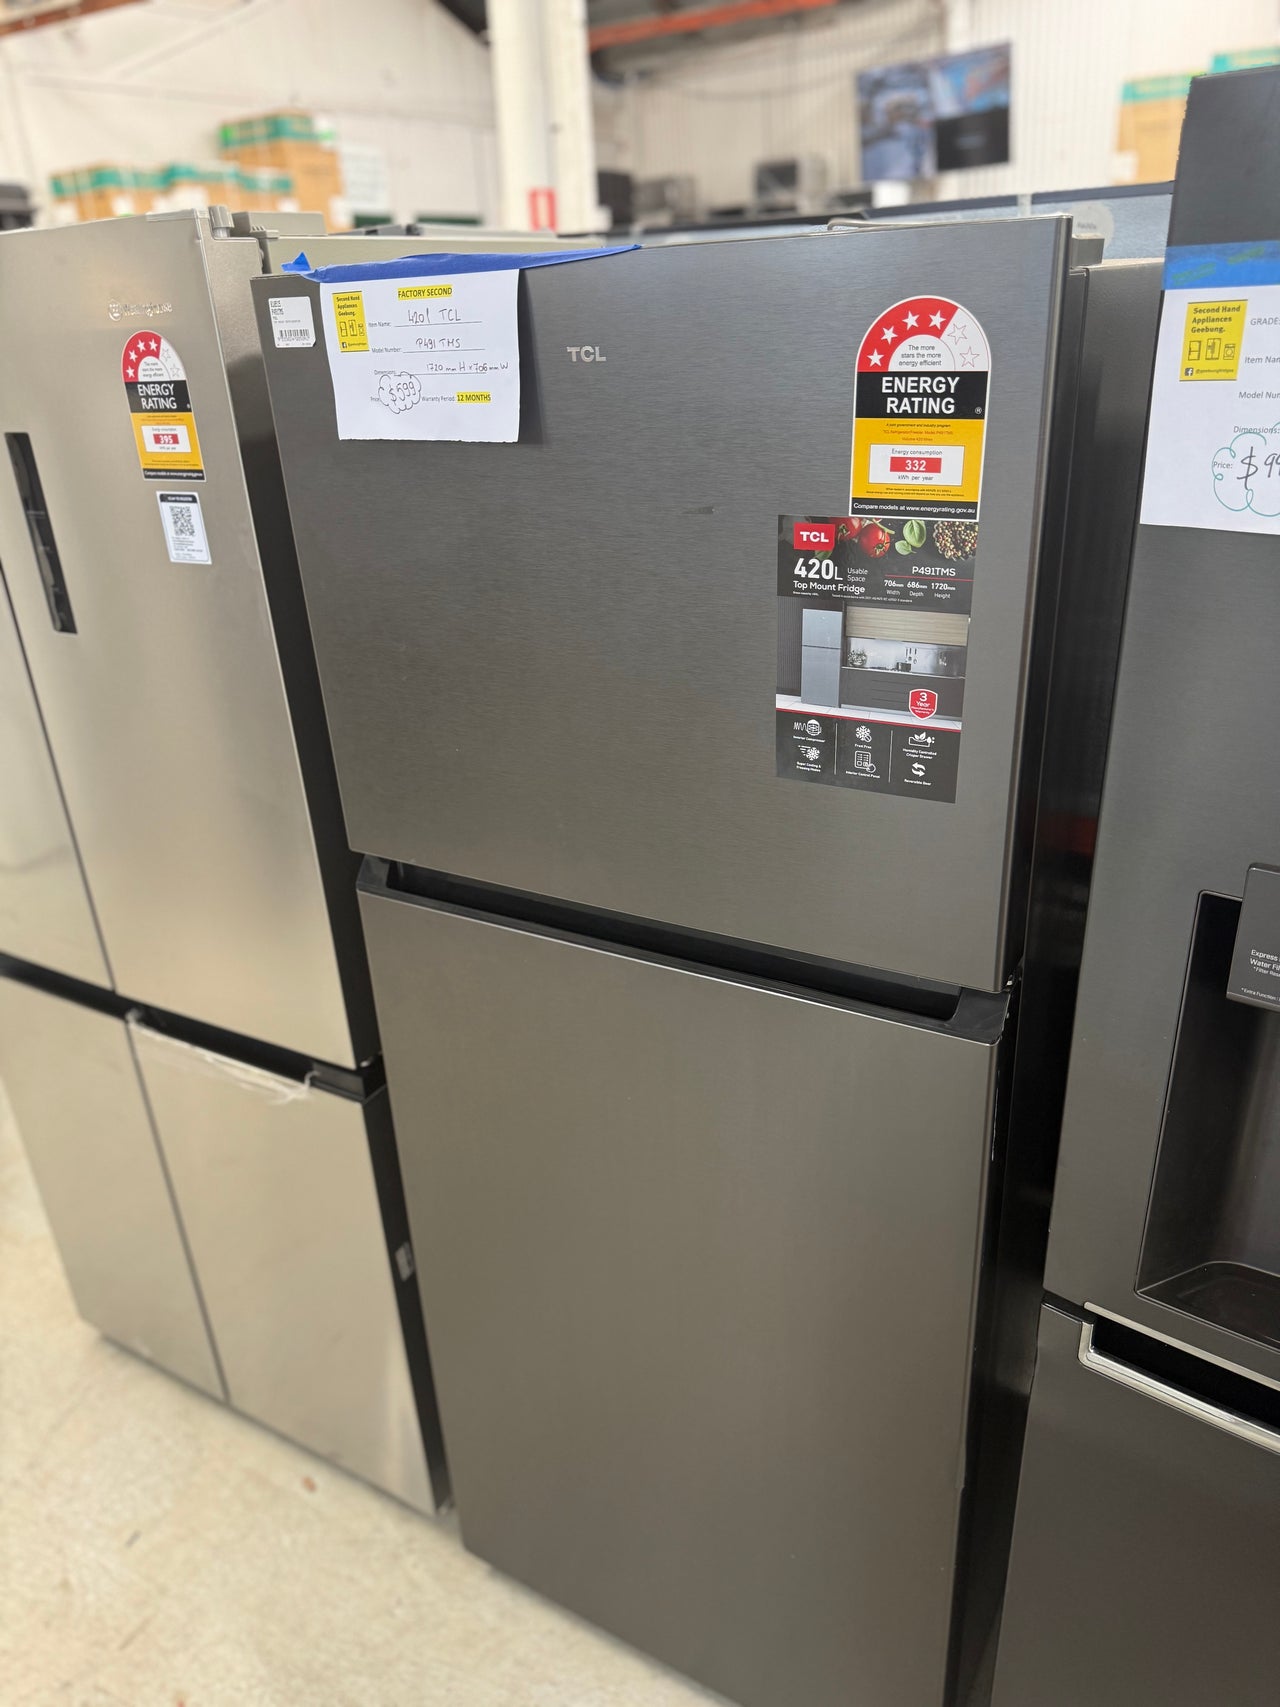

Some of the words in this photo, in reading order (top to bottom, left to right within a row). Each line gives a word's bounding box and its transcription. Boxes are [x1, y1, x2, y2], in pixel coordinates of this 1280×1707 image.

[398, 291, 425, 299] FACTORY
[427, 288, 453, 297] SECOND
[438, 309, 461, 322] TCL
[1194, 307, 1220, 315] Second
[1222, 305, 1241, 313] Hand
[1192, 316, 1232, 326] Appliances
[567, 346, 607, 362] TCL
[1245, 356, 1262, 364] Item
[138, 384, 174, 396] ENERGY
[882, 377, 960, 394] ENERGY
[457, 394, 465, 402] 12
[466, 394, 491, 402] MONTHS
[1239, 391, 1263, 399] Model
[141, 398, 177, 409] RATING
[886, 397, 956, 414] RATING
[160, 435, 174, 445] 395
[892, 448, 910, 456] Energy
[905, 460, 927, 471] 332
[1214, 461, 1233, 470] Price:
[854, 503, 878, 511] Compare
[906, 505, 976, 514] www.energyrating.gov.au
[800, 531, 829, 543] TCL
[794, 558, 843, 582] 420L
[847, 567, 869, 576] Usable
[912, 566, 956, 578] P491TMS
[847, 575, 866, 584] Space
[793, 581, 808, 590] Top
[810, 583, 837, 591] Mount
[838, 584, 865, 595] Fridge
[920, 692, 928, 702] 3
[1251, 949, 1279, 962] Express
[1250, 958, 1272, 969] Water
